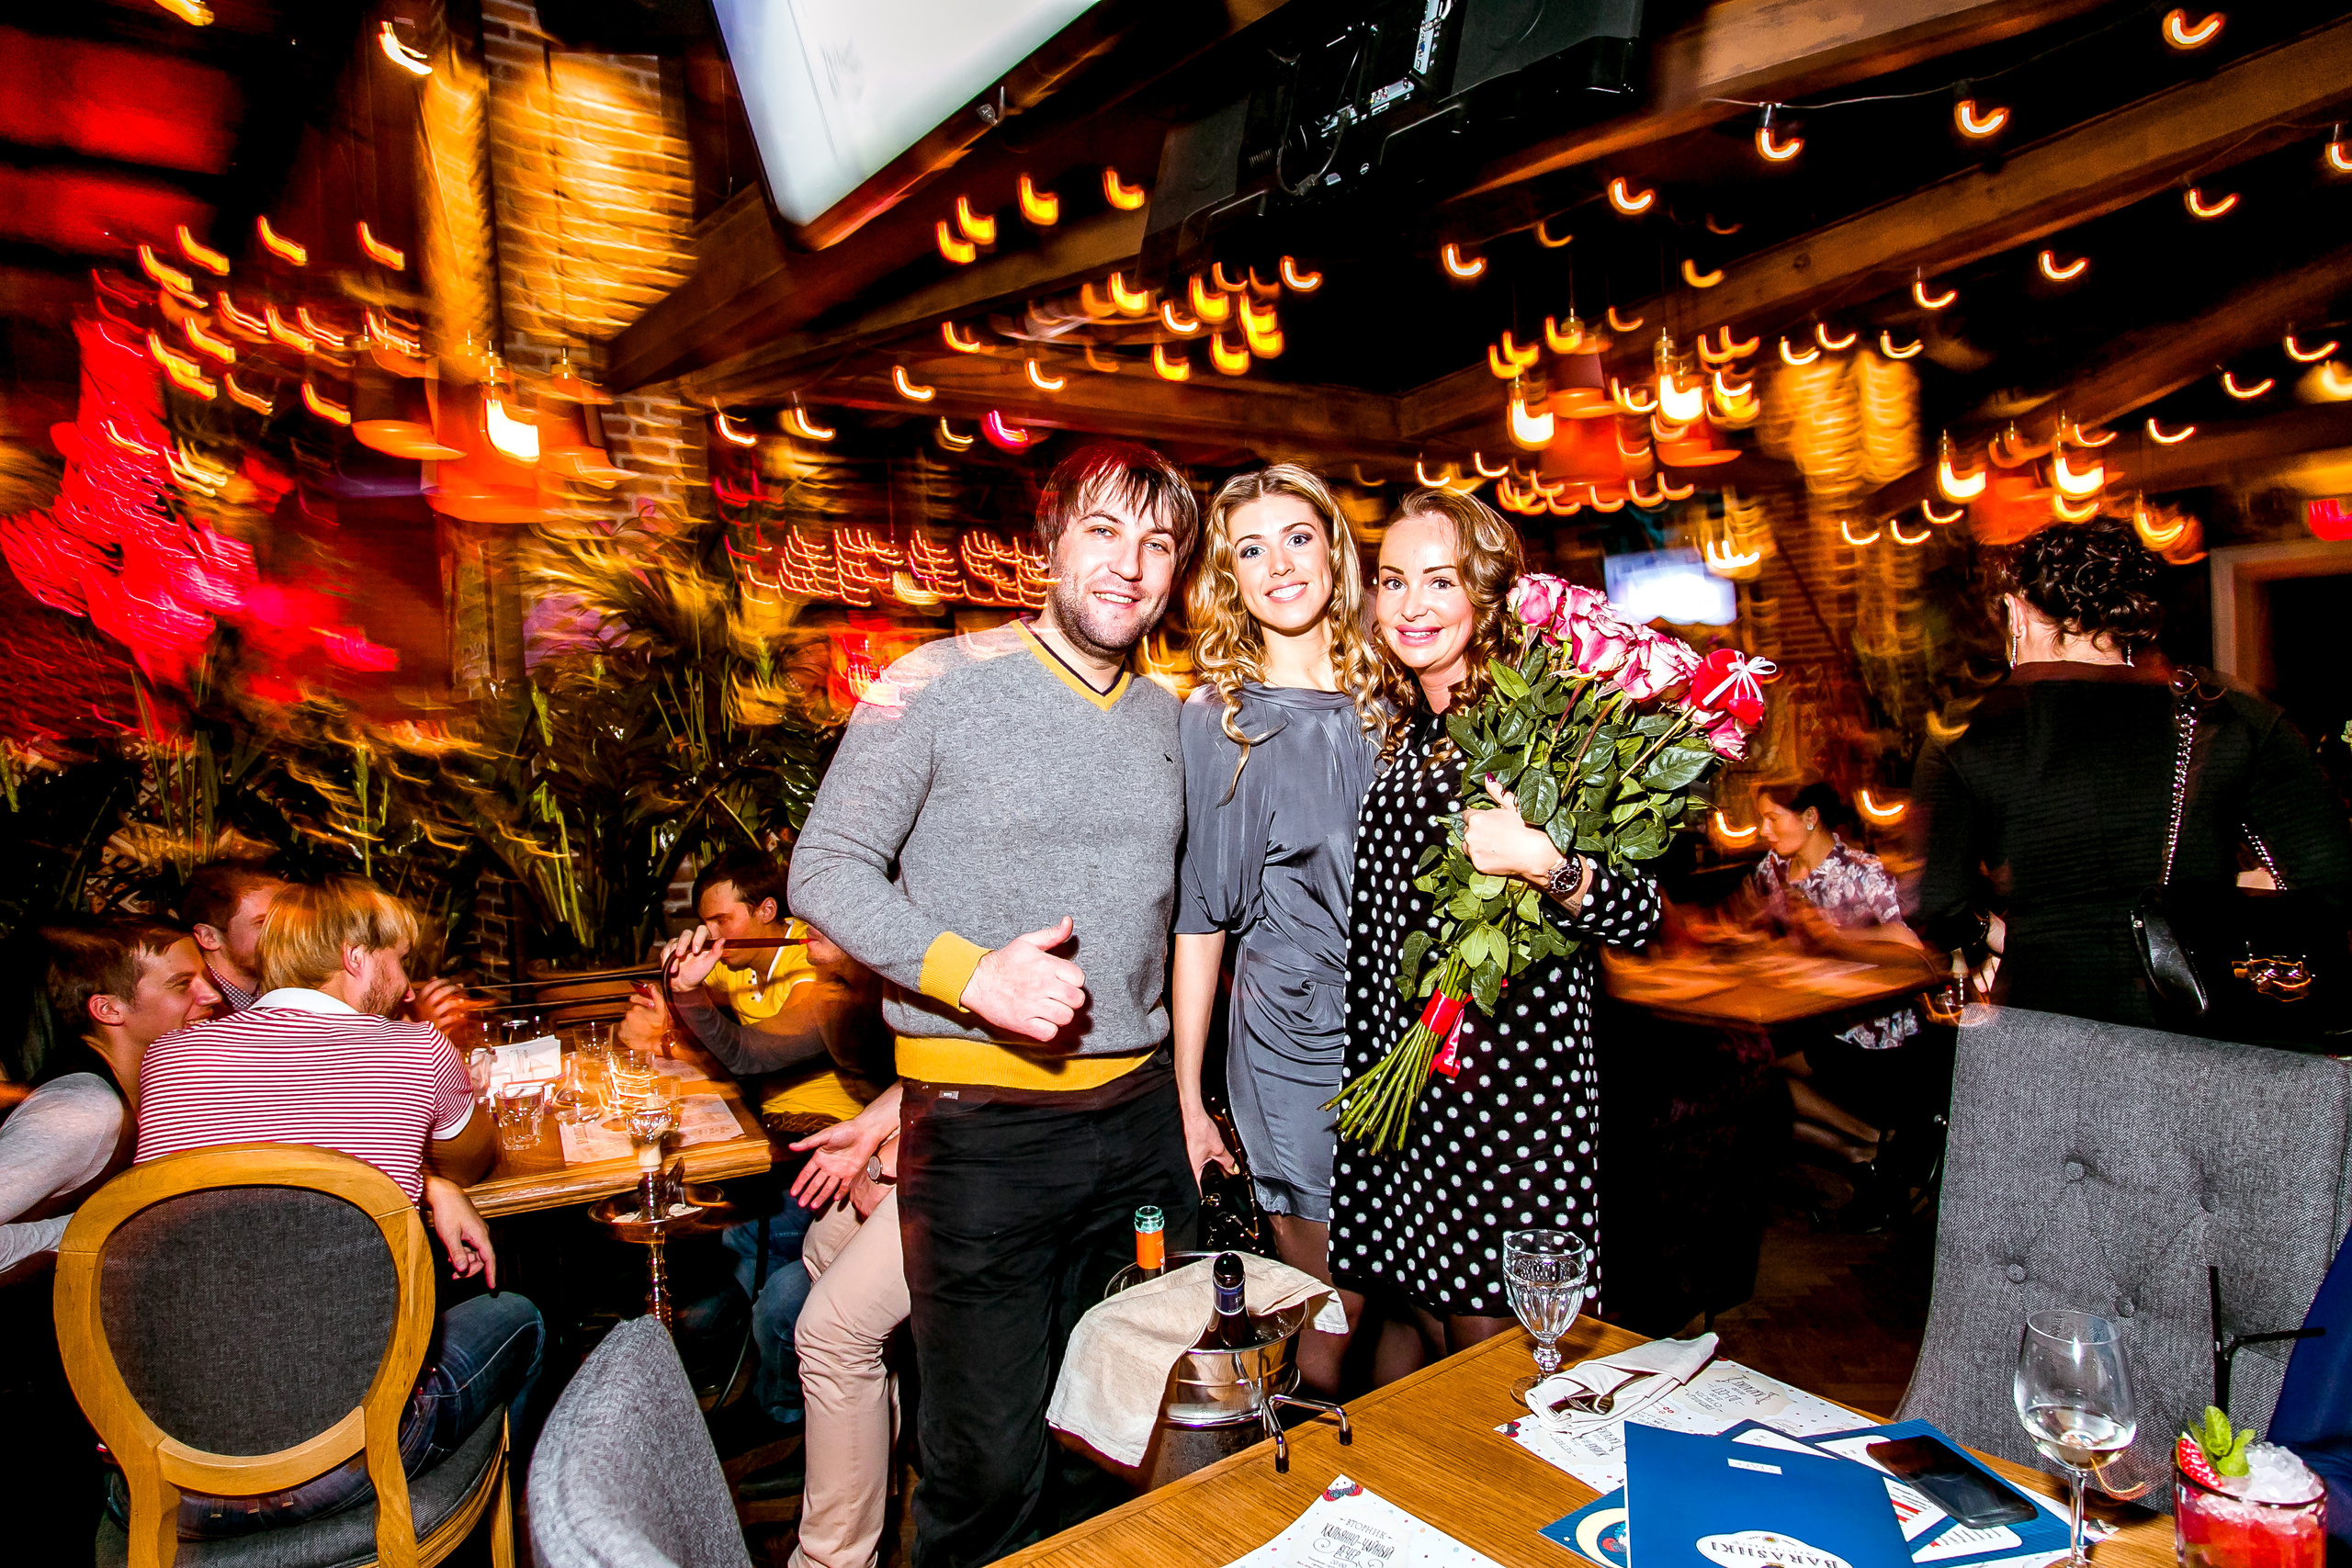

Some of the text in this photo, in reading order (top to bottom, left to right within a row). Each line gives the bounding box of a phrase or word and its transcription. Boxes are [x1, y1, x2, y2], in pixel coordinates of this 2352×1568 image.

[1345, 1517, 1387, 1540] ВТОРНИК
[1320, 1522, 1395, 1561] КАЛЬЯННО-ЧАЙНЫЙ
[1334, 1544, 1362, 1561] ВЕЧЕР
[1711, 1541, 1838, 1568] BARASHKI
